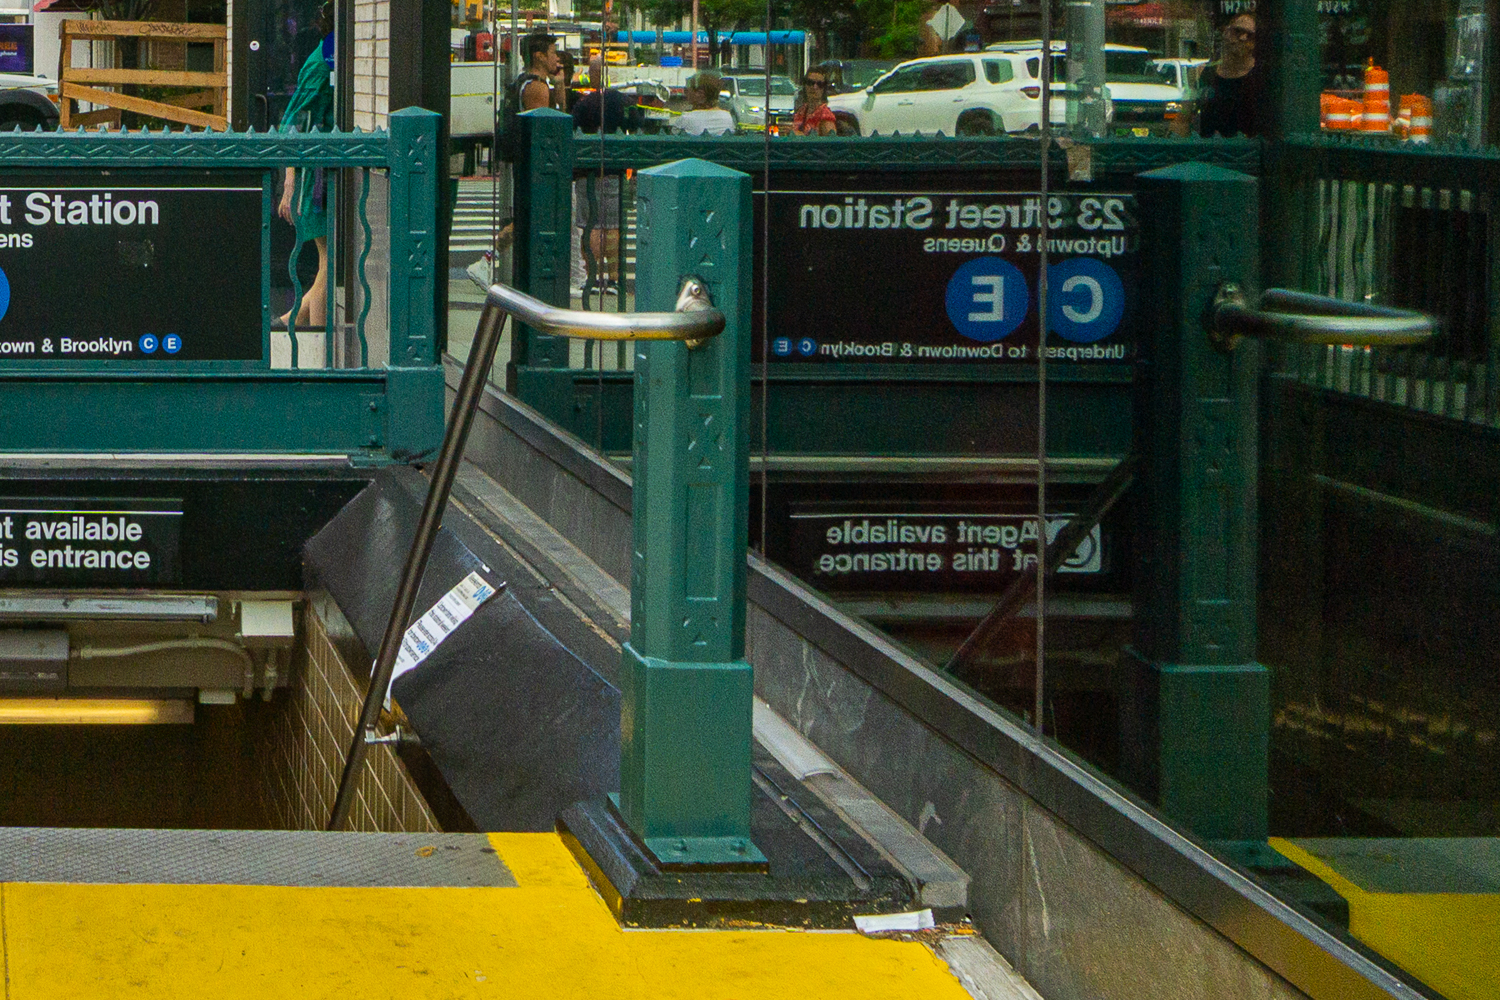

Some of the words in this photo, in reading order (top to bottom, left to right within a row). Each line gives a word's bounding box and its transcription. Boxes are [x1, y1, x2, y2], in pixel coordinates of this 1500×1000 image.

[24, 192, 159, 226] Station
[42, 339, 54, 354] &
[60, 338, 133, 355] Brooklyn
[25, 516, 143, 542] available
[30, 547, 151, 569] entrance
